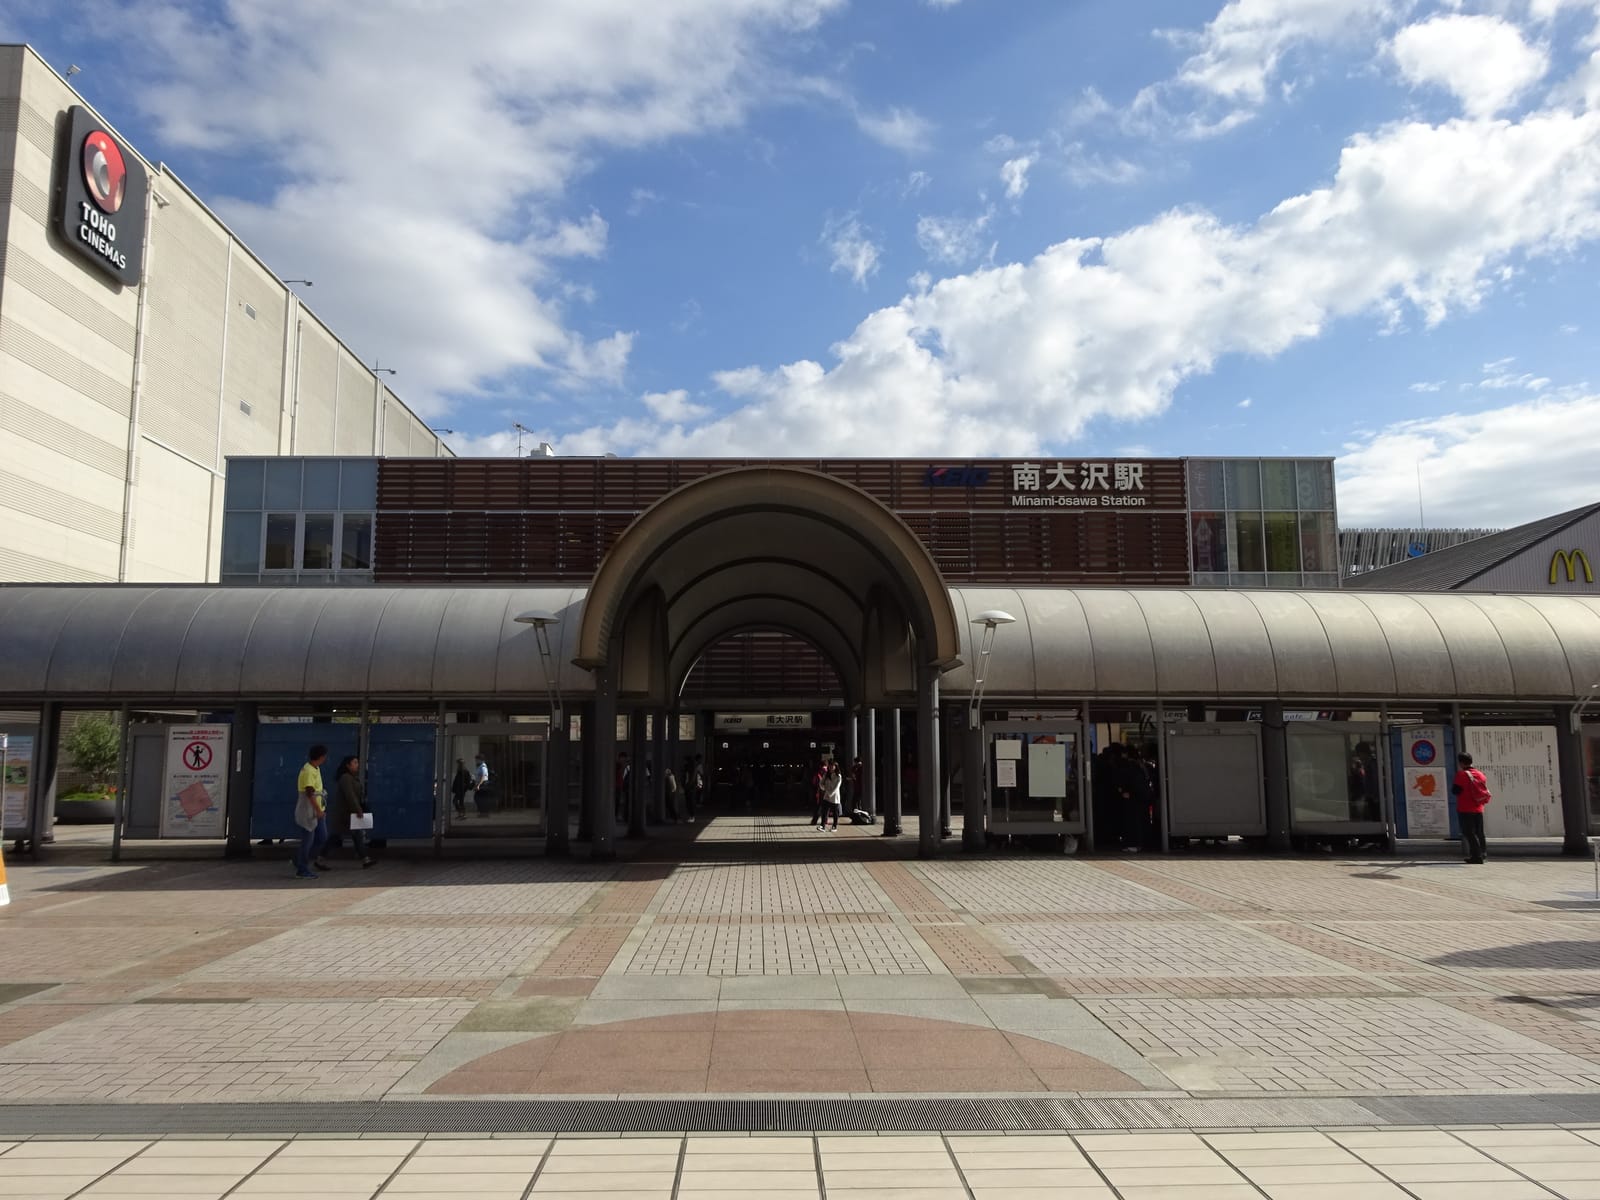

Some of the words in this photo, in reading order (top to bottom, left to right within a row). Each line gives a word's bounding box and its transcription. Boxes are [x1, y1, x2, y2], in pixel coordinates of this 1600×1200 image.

[82, 202, 116, 242] TOHO
[80, 224, 126, 269] CINEMAS
[924, 468, 990, 486] KEIO
[1011, 462, 1145, 491] 南大沢駅
[1012, 495, 1098, 507] Minami-ōsawa
[1101, 495, 1146, 507] Station
[767, 715, 803, 724] 南大沢駅
